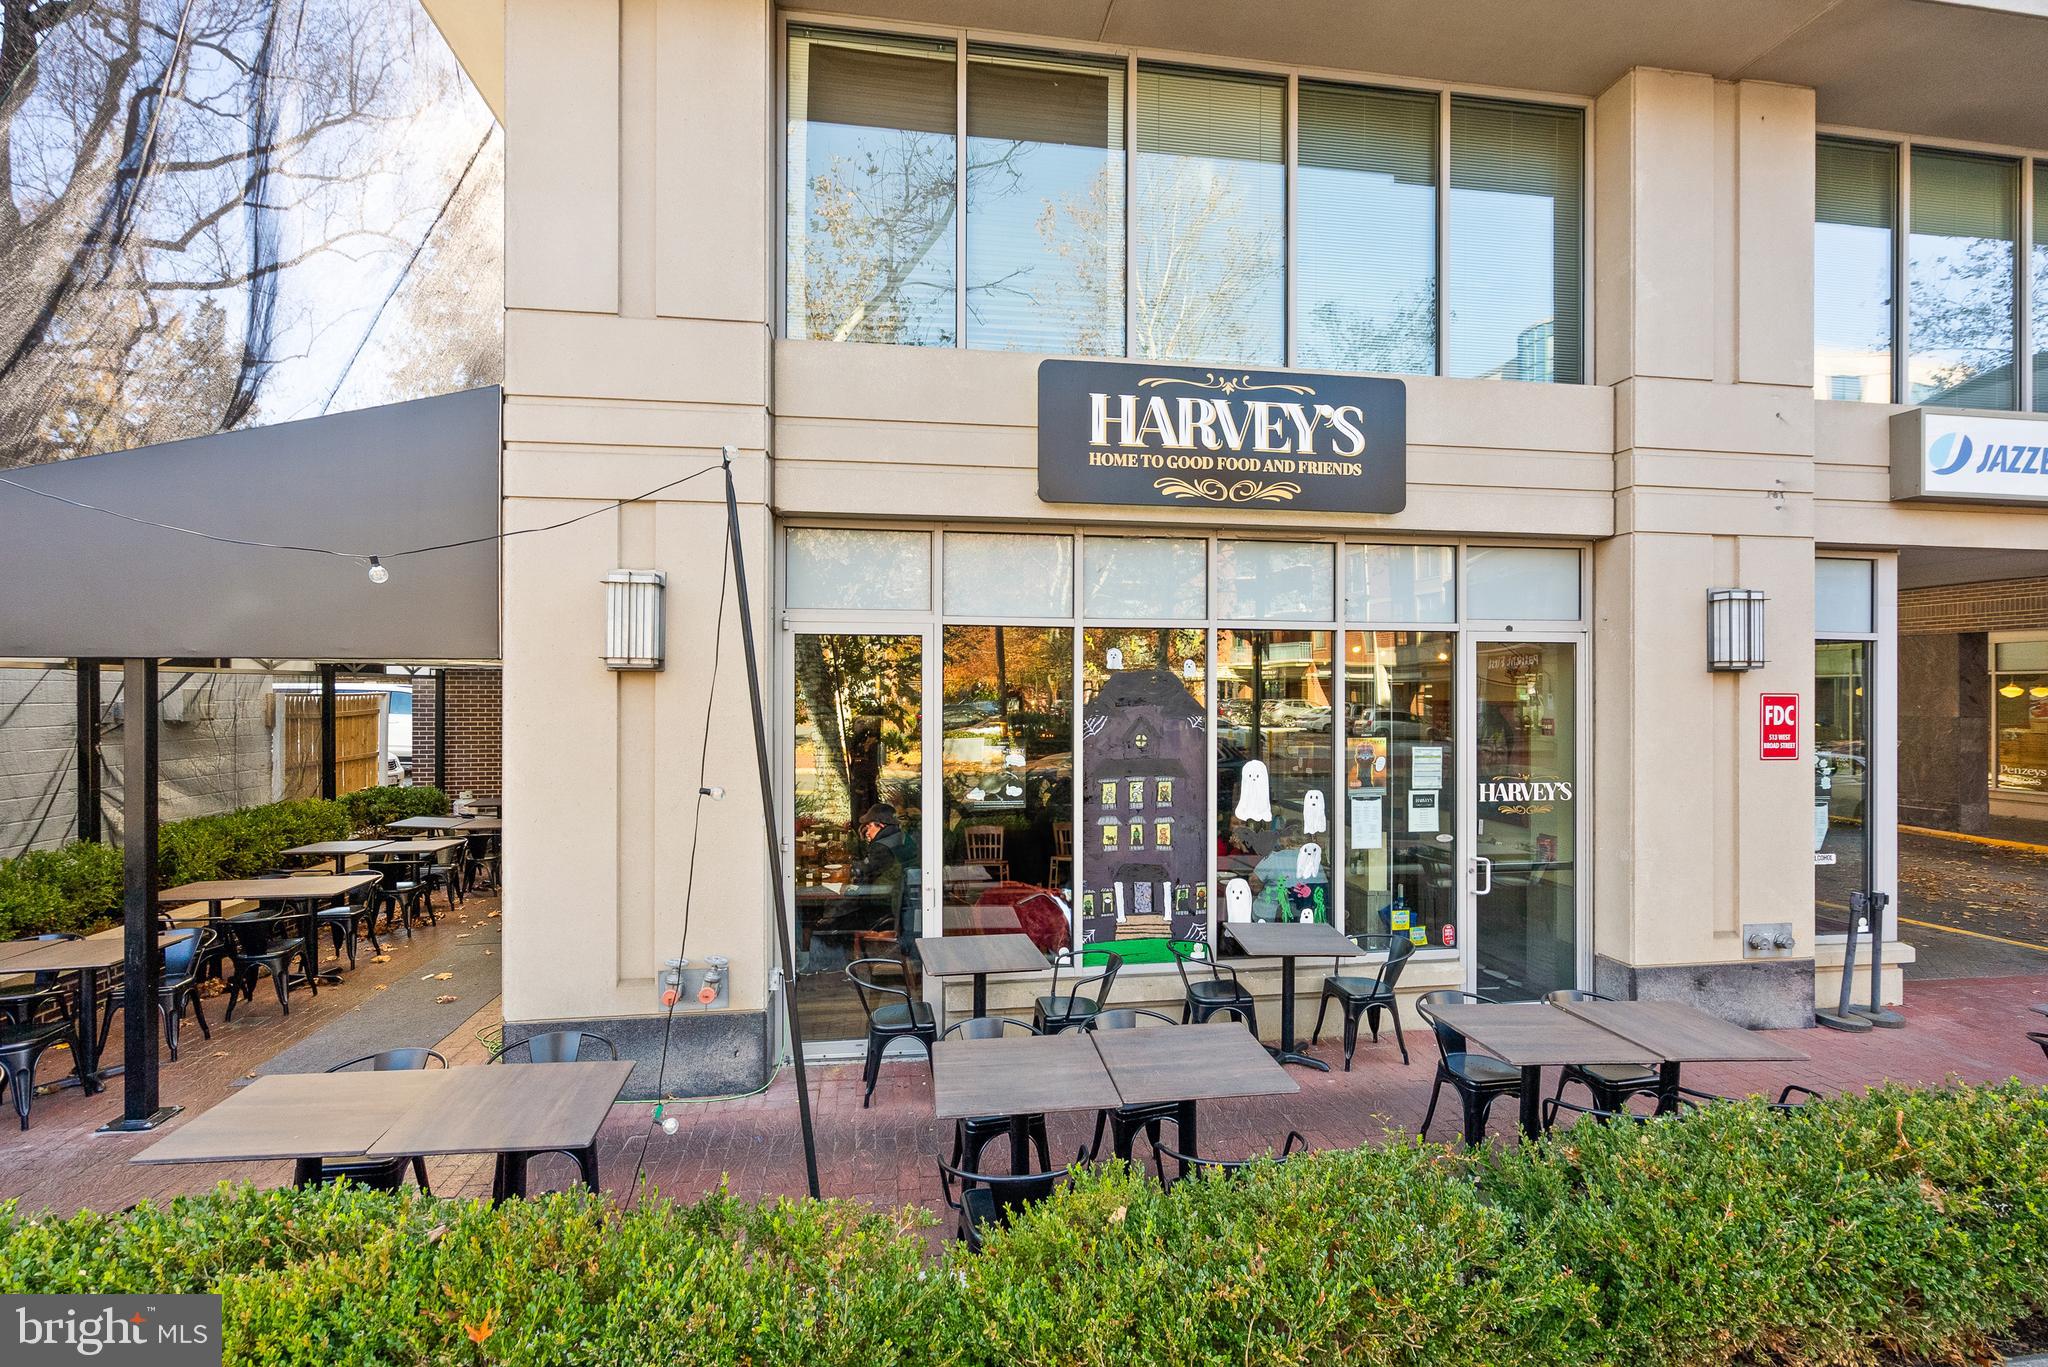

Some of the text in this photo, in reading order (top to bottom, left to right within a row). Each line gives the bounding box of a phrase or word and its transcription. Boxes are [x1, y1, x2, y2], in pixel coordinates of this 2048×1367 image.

[1089, 393, 1367, 456] HARVEY'S
[1089, 452, 1362, 476] HOME TO GOOD FOOD AND FRIENDS
[1765, 705, 1795, 726] FDC
[2000, 764, 2048, 778] Penzeys
[1479, 781, 1573, 802] HARVEY'S
